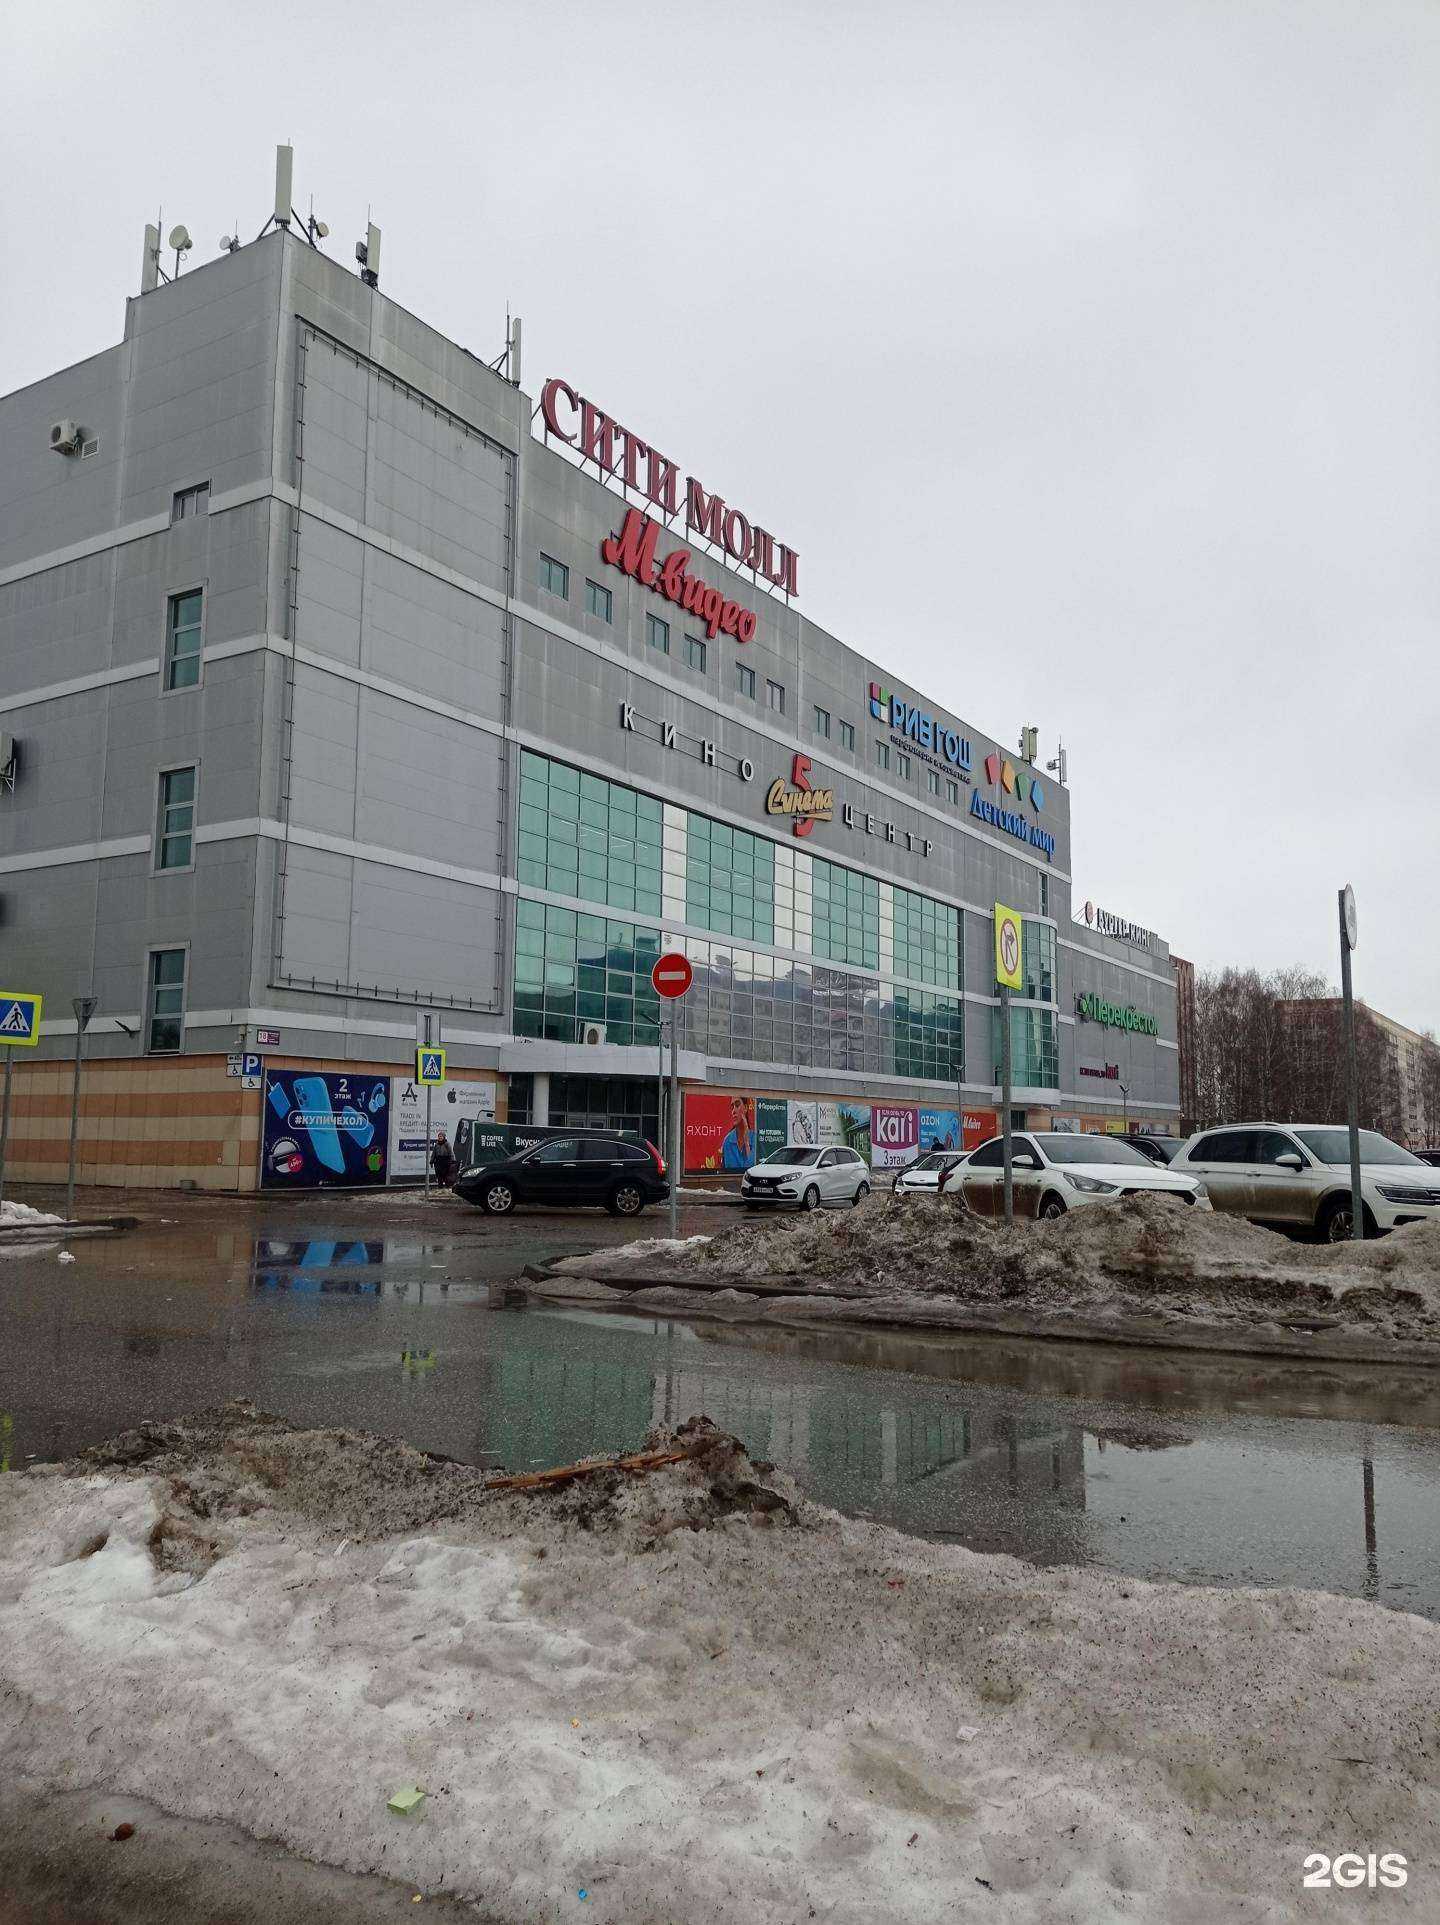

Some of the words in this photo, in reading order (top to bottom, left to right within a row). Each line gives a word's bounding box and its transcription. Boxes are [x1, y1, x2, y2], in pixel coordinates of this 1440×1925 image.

[541, 378, 681, 517] СИТИ
[685, 476, 800, 597] МОЛЛ
[601, 508, 757, 642] М.видео
[890, 694, 933, 748] РИВ
[933, 721, 972, 771] ГОШ
[766, 776, 833, 821] Синема
[969, 788, 1031, 841] Детский
[842, 801, 934, 858] ЦЕНТР
[339, 1079, 348, 1092] 2
[294, 1114, 364, 1127] #КУПИЧЕХОЛ
[686, 1126, 722, 1136] ЯХОНТ
[876, 1109, 913, 1143] kari
[921, 1116, 940, 1127] OZON
